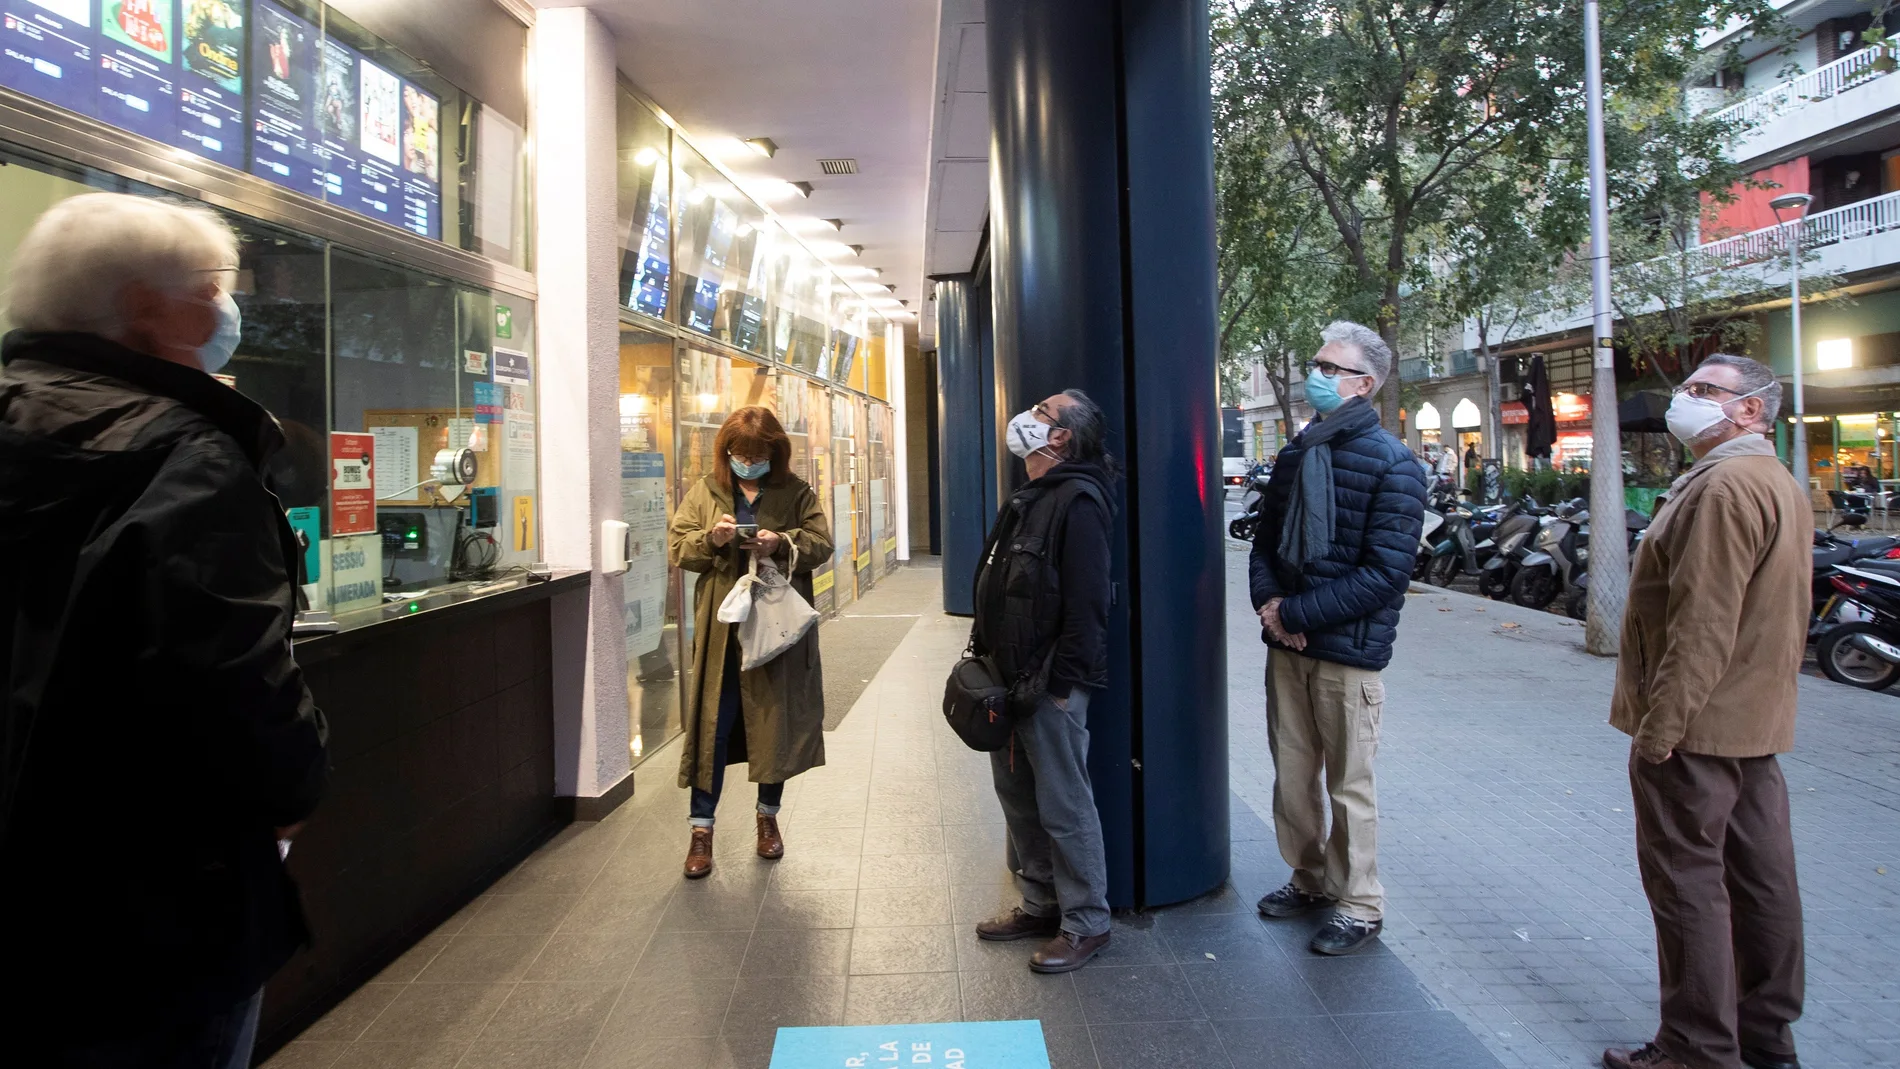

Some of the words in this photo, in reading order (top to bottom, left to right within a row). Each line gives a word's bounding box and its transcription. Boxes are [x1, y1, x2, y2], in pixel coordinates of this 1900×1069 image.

[343, 465, 361, 474] BONUS
[326, 580, 376, 606] NUMERADA
[845, 1052, 870, 1069] R,
[878, 1040, 899, 1061] LA
[911, 1042, 932, 1064] DE
